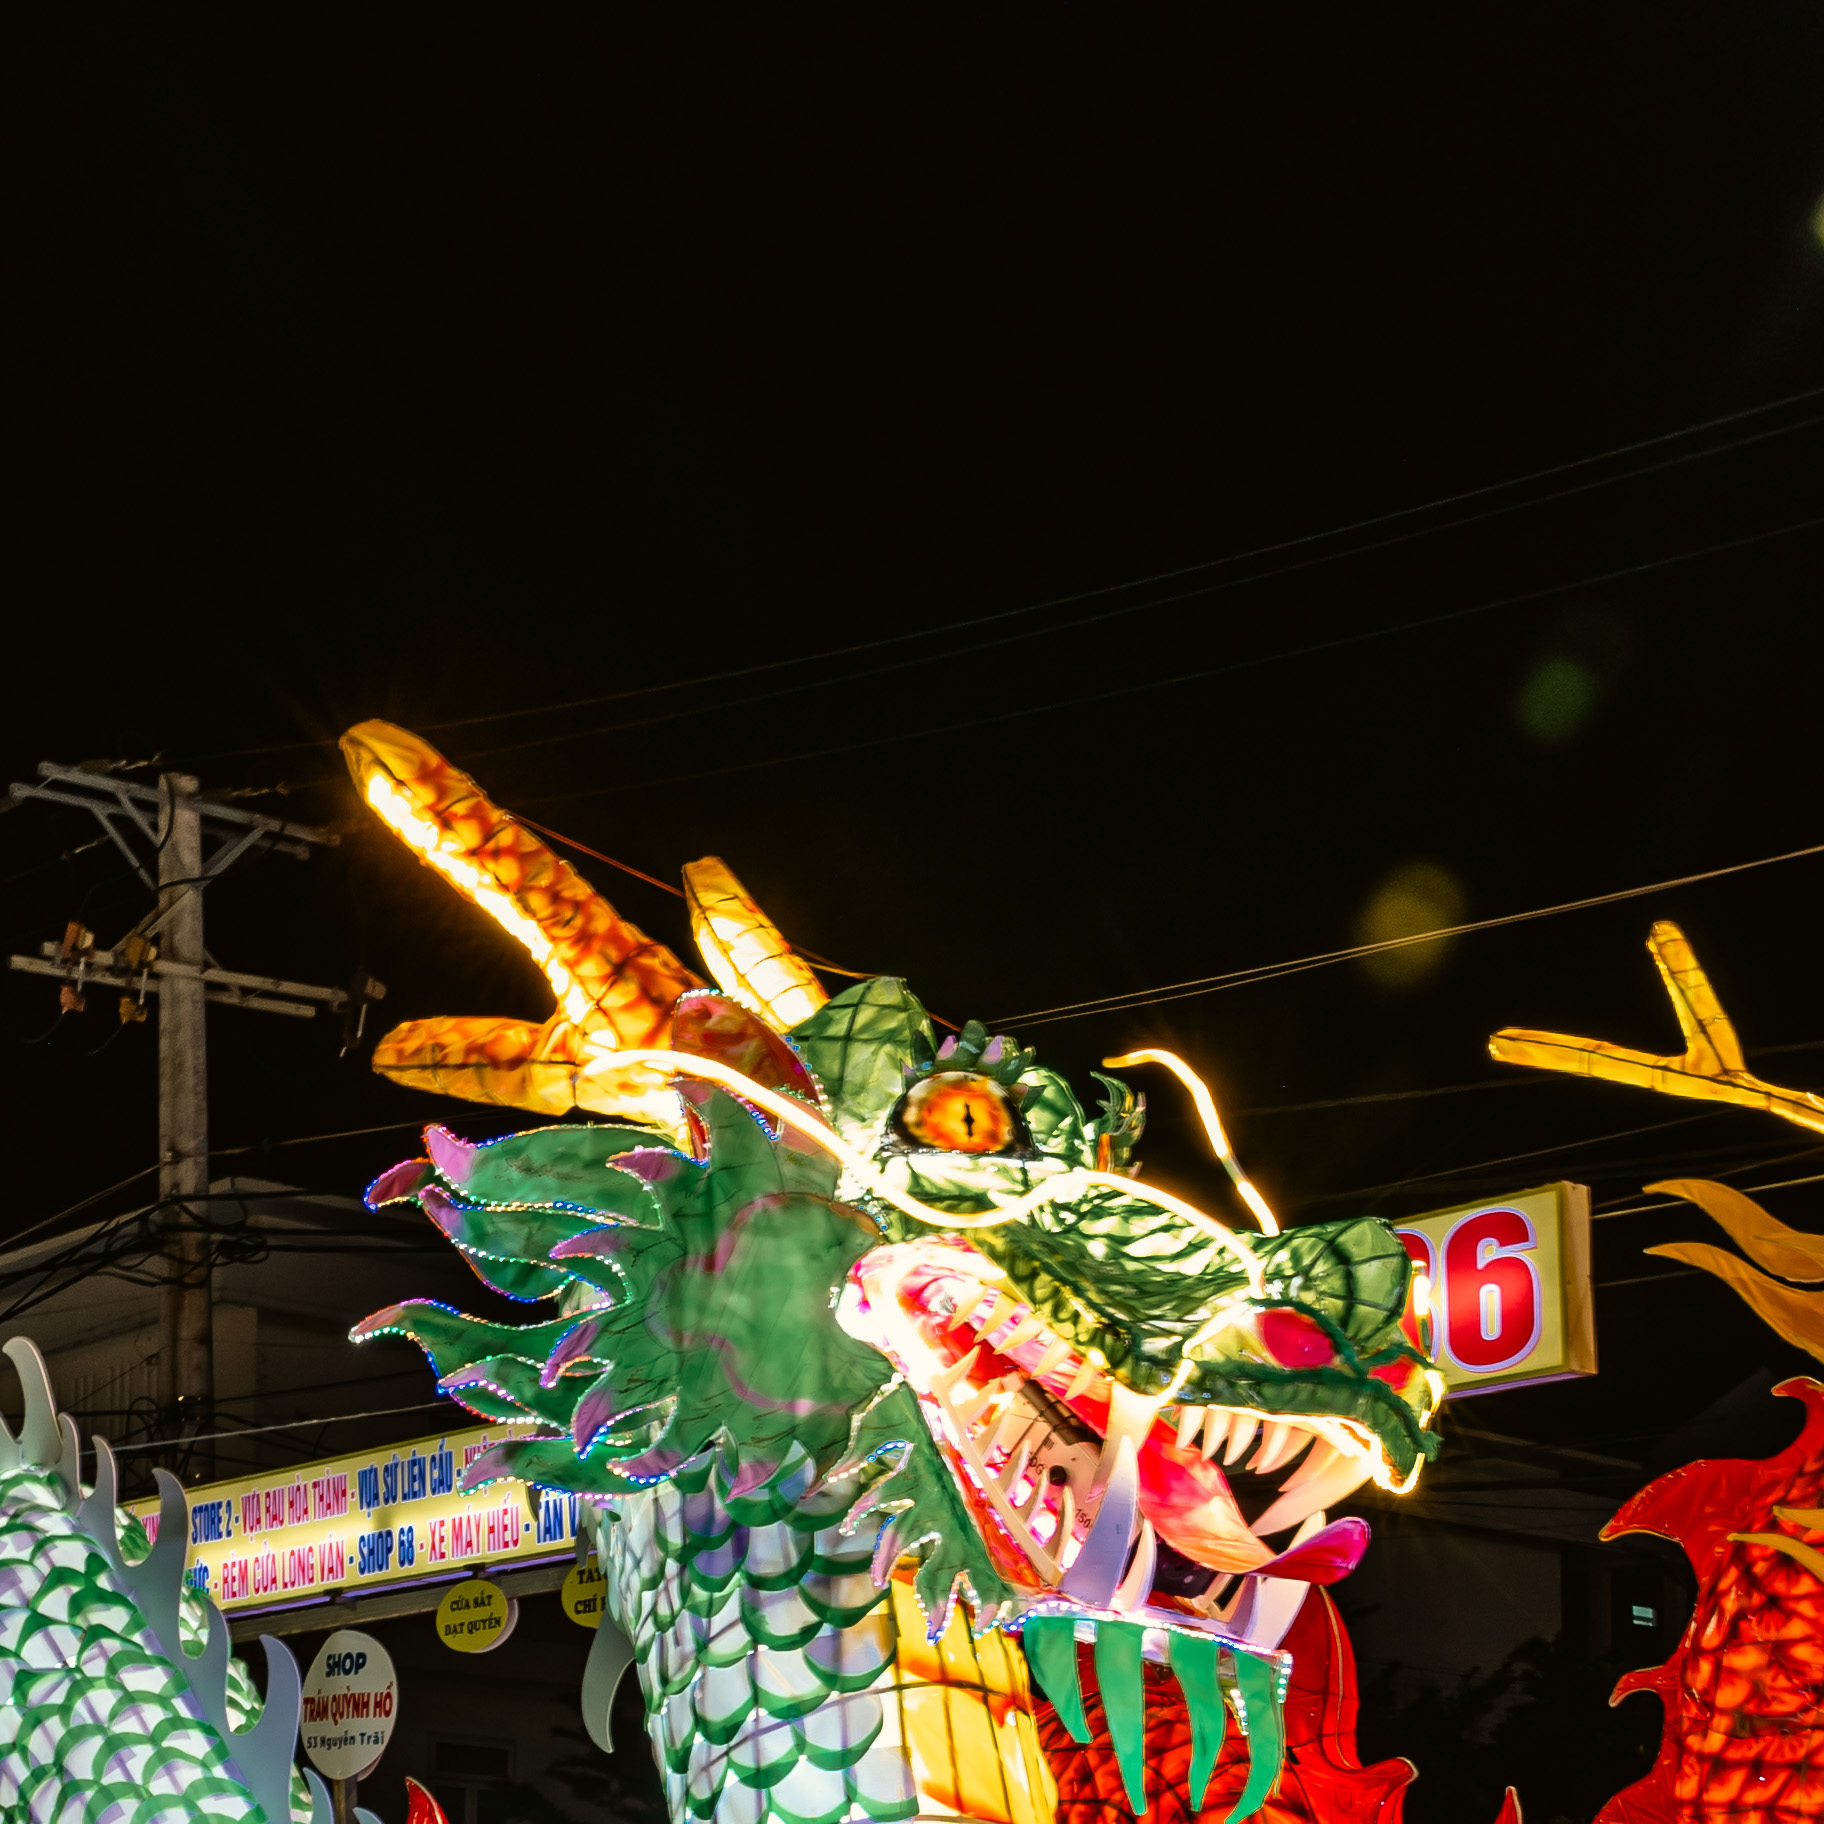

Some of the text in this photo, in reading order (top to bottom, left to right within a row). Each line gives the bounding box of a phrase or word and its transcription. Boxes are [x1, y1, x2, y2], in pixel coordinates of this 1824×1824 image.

[191, 1502, 223, 1545] STORE
[225, 1499, 232, 1539] 2
[264, 1487, 285, 1530] RAU
[281, 1545, 314, 1590] LONG
[358, 1528, 394, 1575] SHOP
[397, 1525, 414, 1567] 68
[428, 1519, 446, 1562] XE
[451, 1504, 482, 1559] MÁY
[326, 1652, 367, 1677] SHOP
[307, 1736, 318, 1749] 53
